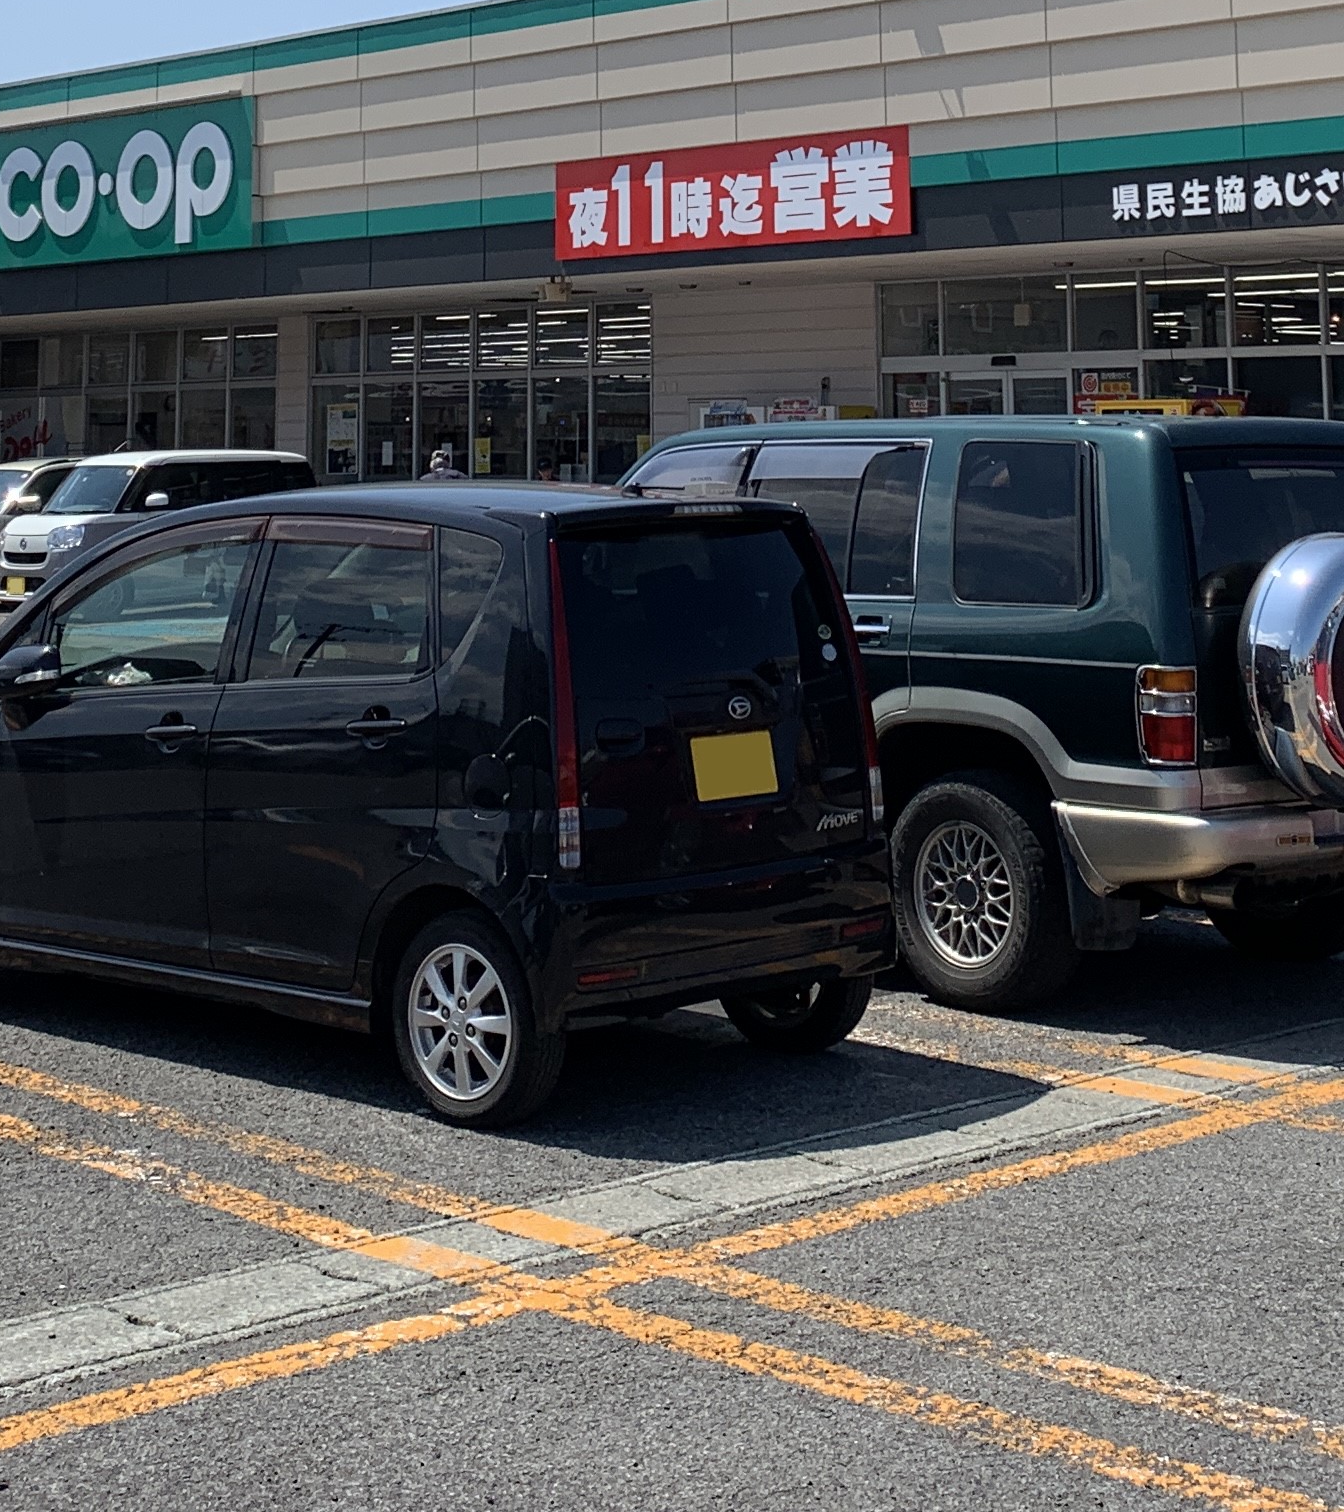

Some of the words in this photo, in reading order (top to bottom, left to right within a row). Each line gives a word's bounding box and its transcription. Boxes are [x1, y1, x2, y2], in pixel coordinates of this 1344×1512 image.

[568, 139, 894, 249] 夜11時迄営業
[816, 811, 859, 832] MOVE
